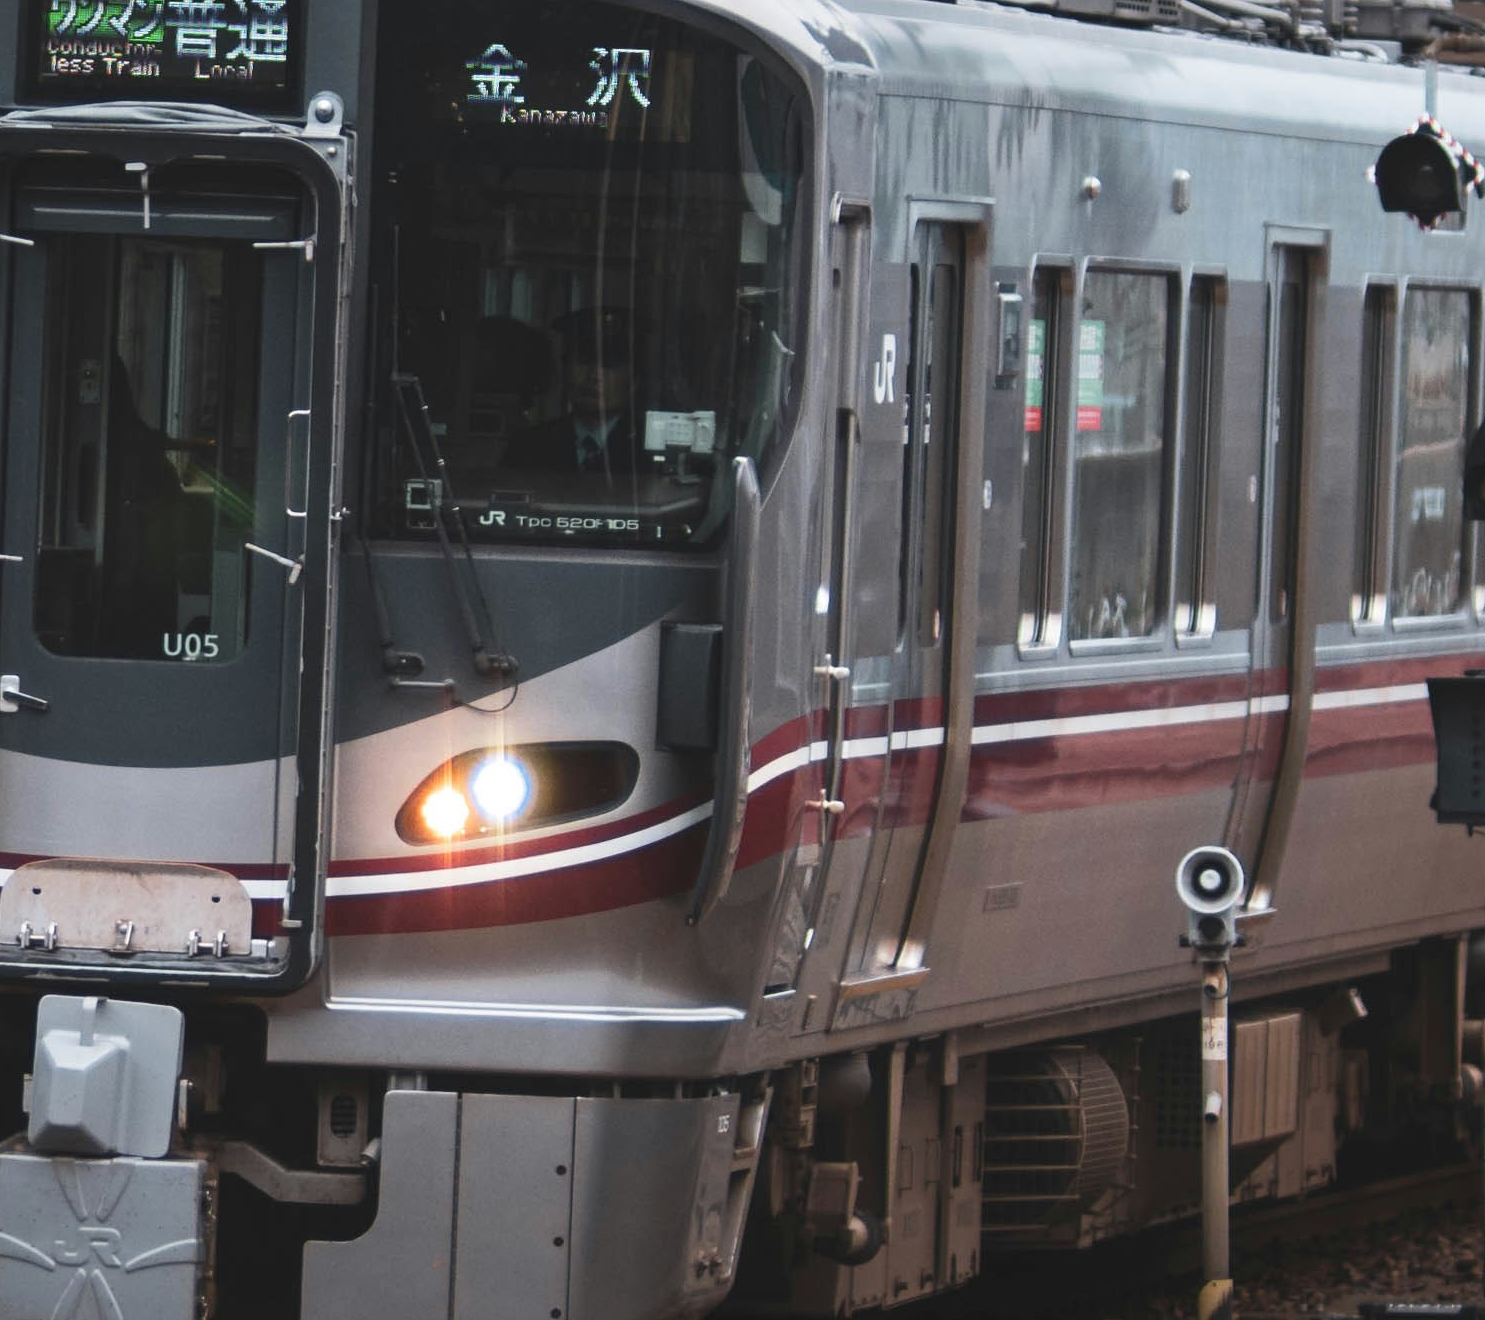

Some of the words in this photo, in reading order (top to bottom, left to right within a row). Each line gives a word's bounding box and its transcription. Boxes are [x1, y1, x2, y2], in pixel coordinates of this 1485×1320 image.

[50, 55, 94, 74] less
[102, 57, 160, 77] Train
[873, 334, 897, 404] JR
[480, 511, 506, 526] JR
[163, 632, 220, 658] U05
[51, 1226, 122, 1268] JR
